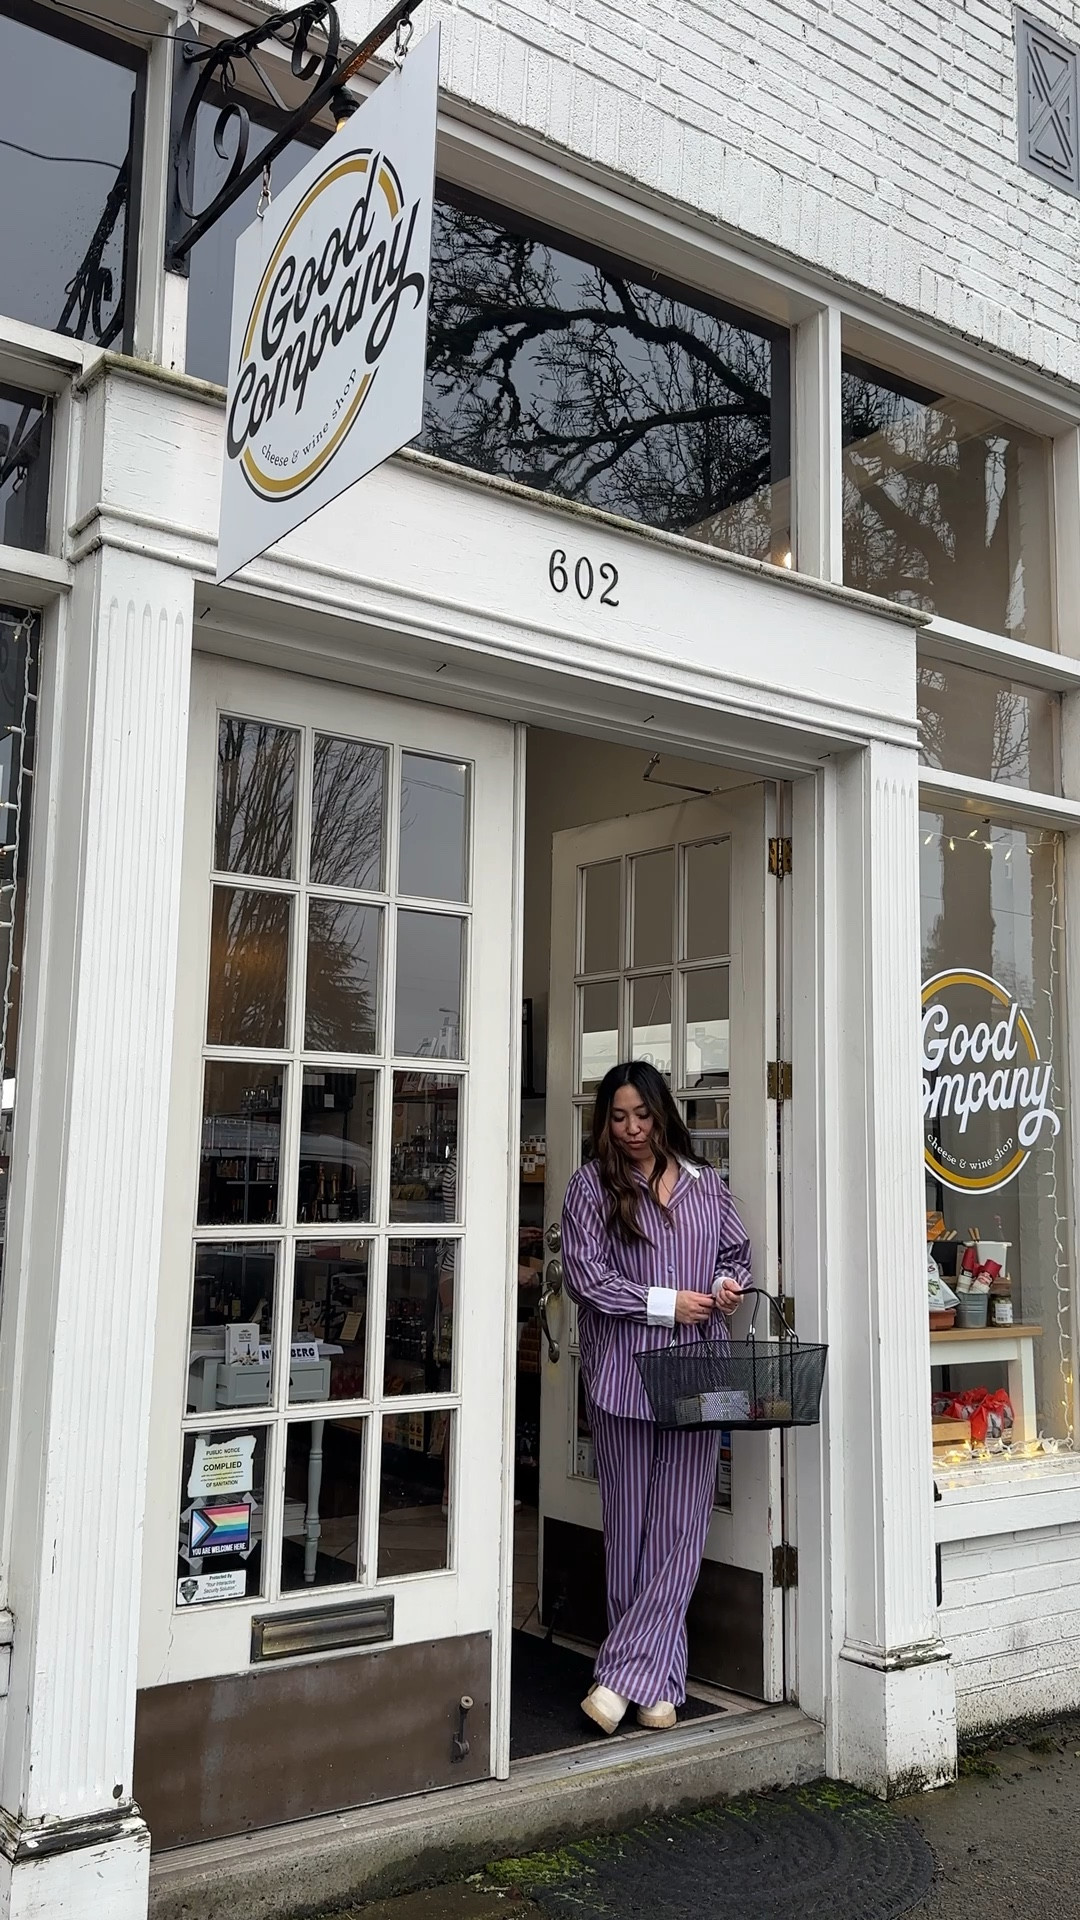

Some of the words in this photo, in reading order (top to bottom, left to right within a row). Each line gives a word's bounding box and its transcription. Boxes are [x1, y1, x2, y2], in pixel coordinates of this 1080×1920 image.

[261, 151, 380, 361] Good
[227, 198, 425, 459] Company
[261, 444, 289, 467] cheese
[291, 449, 300, 464] &
[302, 422, 329, 455] wine
[331, 368, 357, 420] shop
[549, 549, 619, 606] 602
[922, 1004, 1018, 1071] Good
[922, 1065, 1061, 1147] ompany
[927, 1134, 957, 1165] cheese
[959, 1158, 967, 1169] &
[969, 1158, 993, 1170] wine
[994, 1137, 1014, 1162] shop
[261, 1347, 315, 1359] NBERG
[203, 1461, 242, 1471] COMPLIED
[192, 1548, 202, 1556] YOU
[202, 1546, 211, 1555] ARE
[211, 1543, 233, 1554] WELCOME
